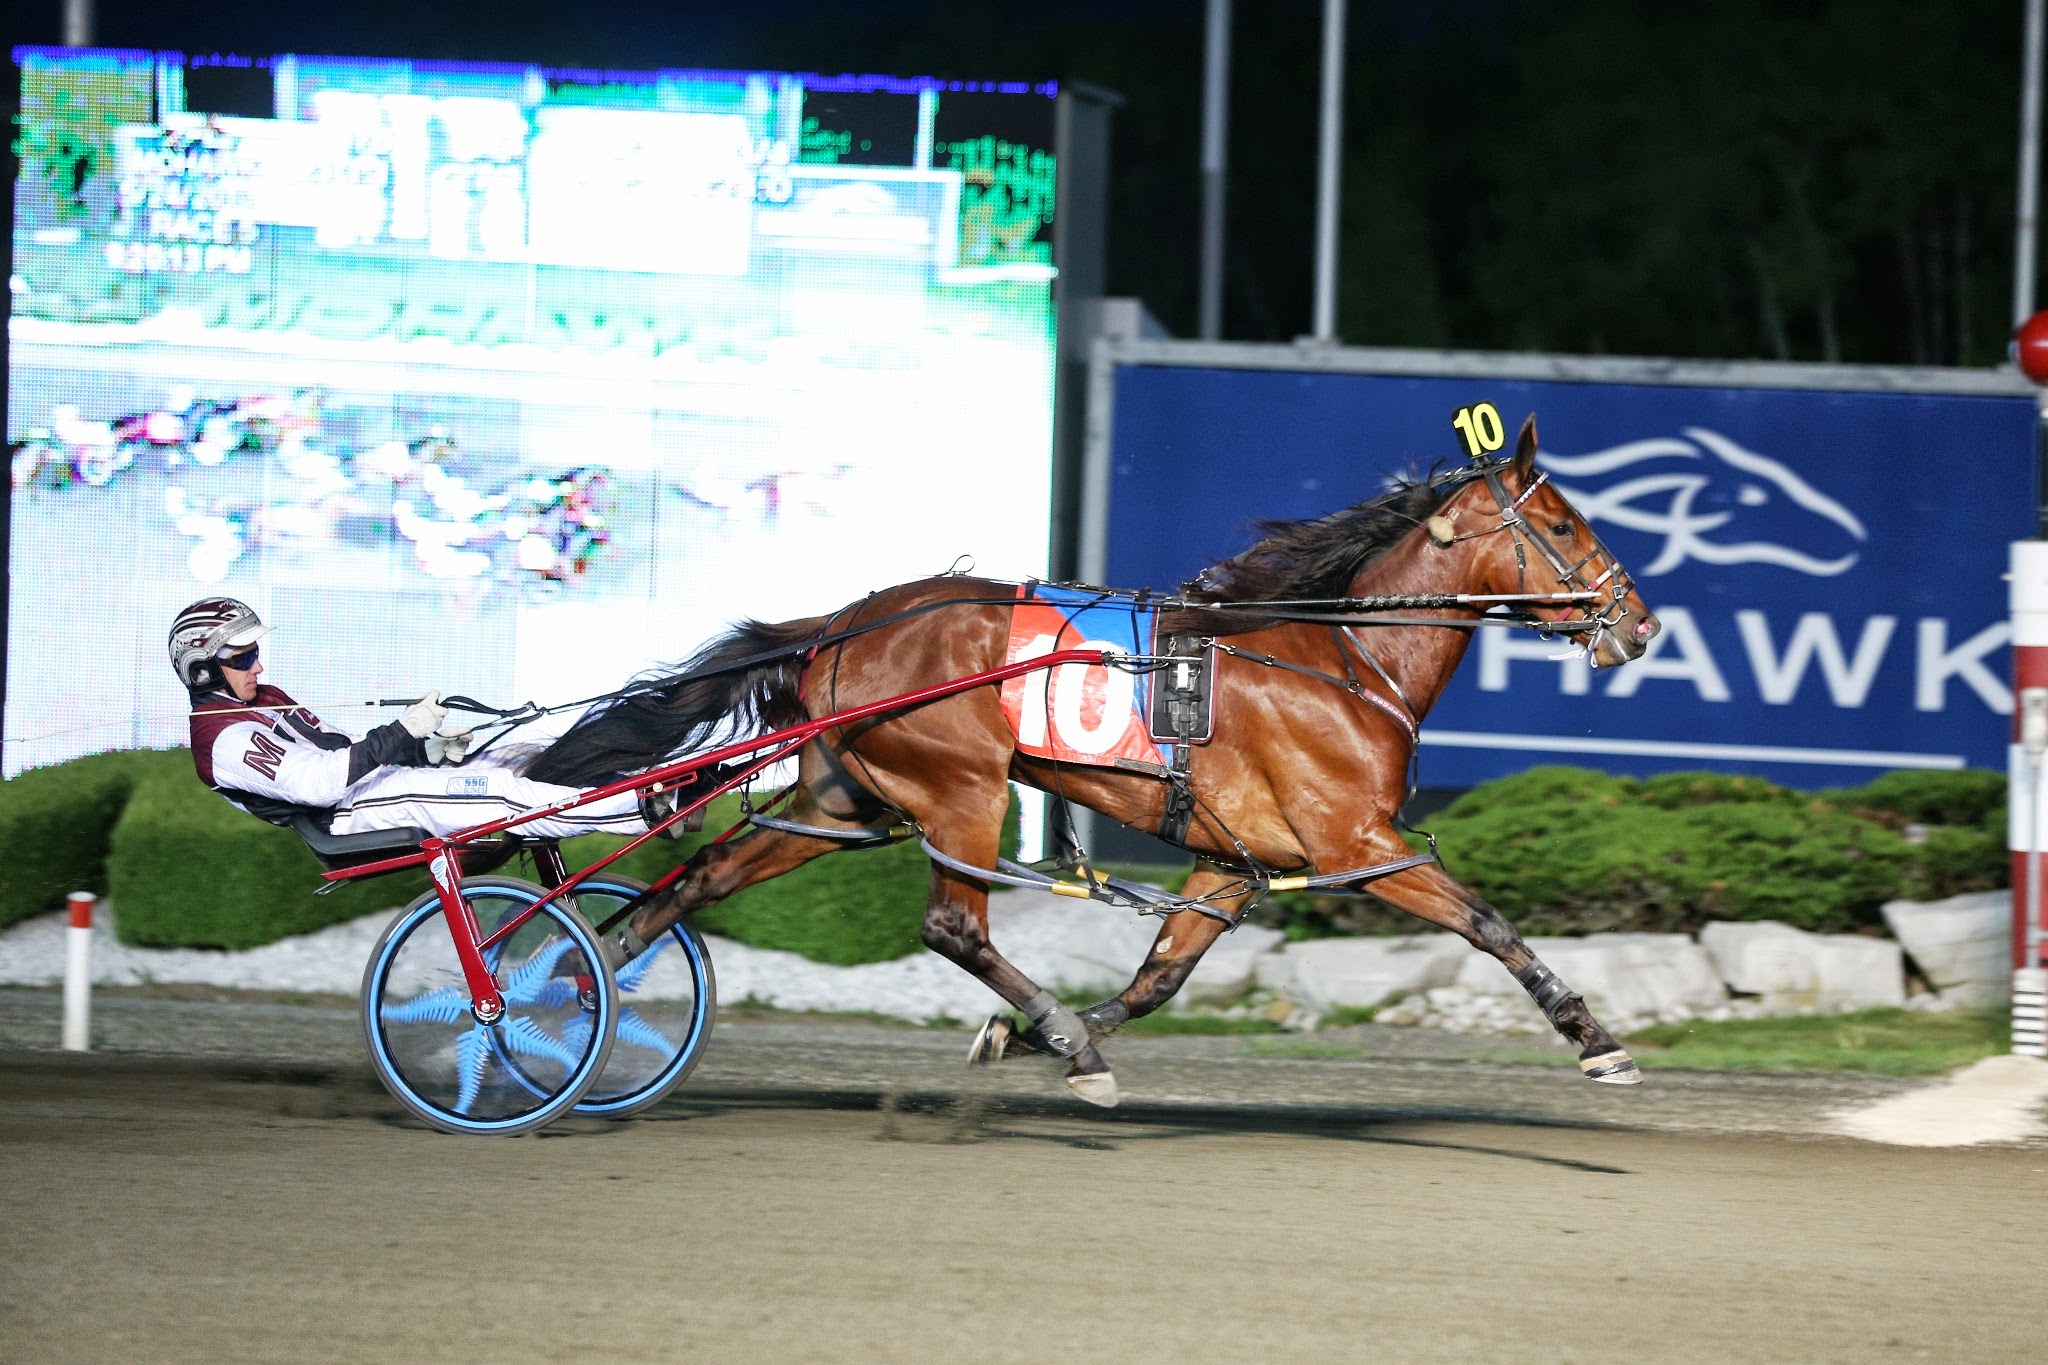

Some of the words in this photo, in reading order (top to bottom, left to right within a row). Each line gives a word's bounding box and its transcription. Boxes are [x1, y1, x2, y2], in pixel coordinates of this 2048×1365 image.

[1453, 403, 1505, 457] 10
[1478, 603, 2012, 717] HAWK
[1015, 633, 1135, 755] 10
[243, 731, 287, 781] M
[464, 778, 485, 786] SSG
